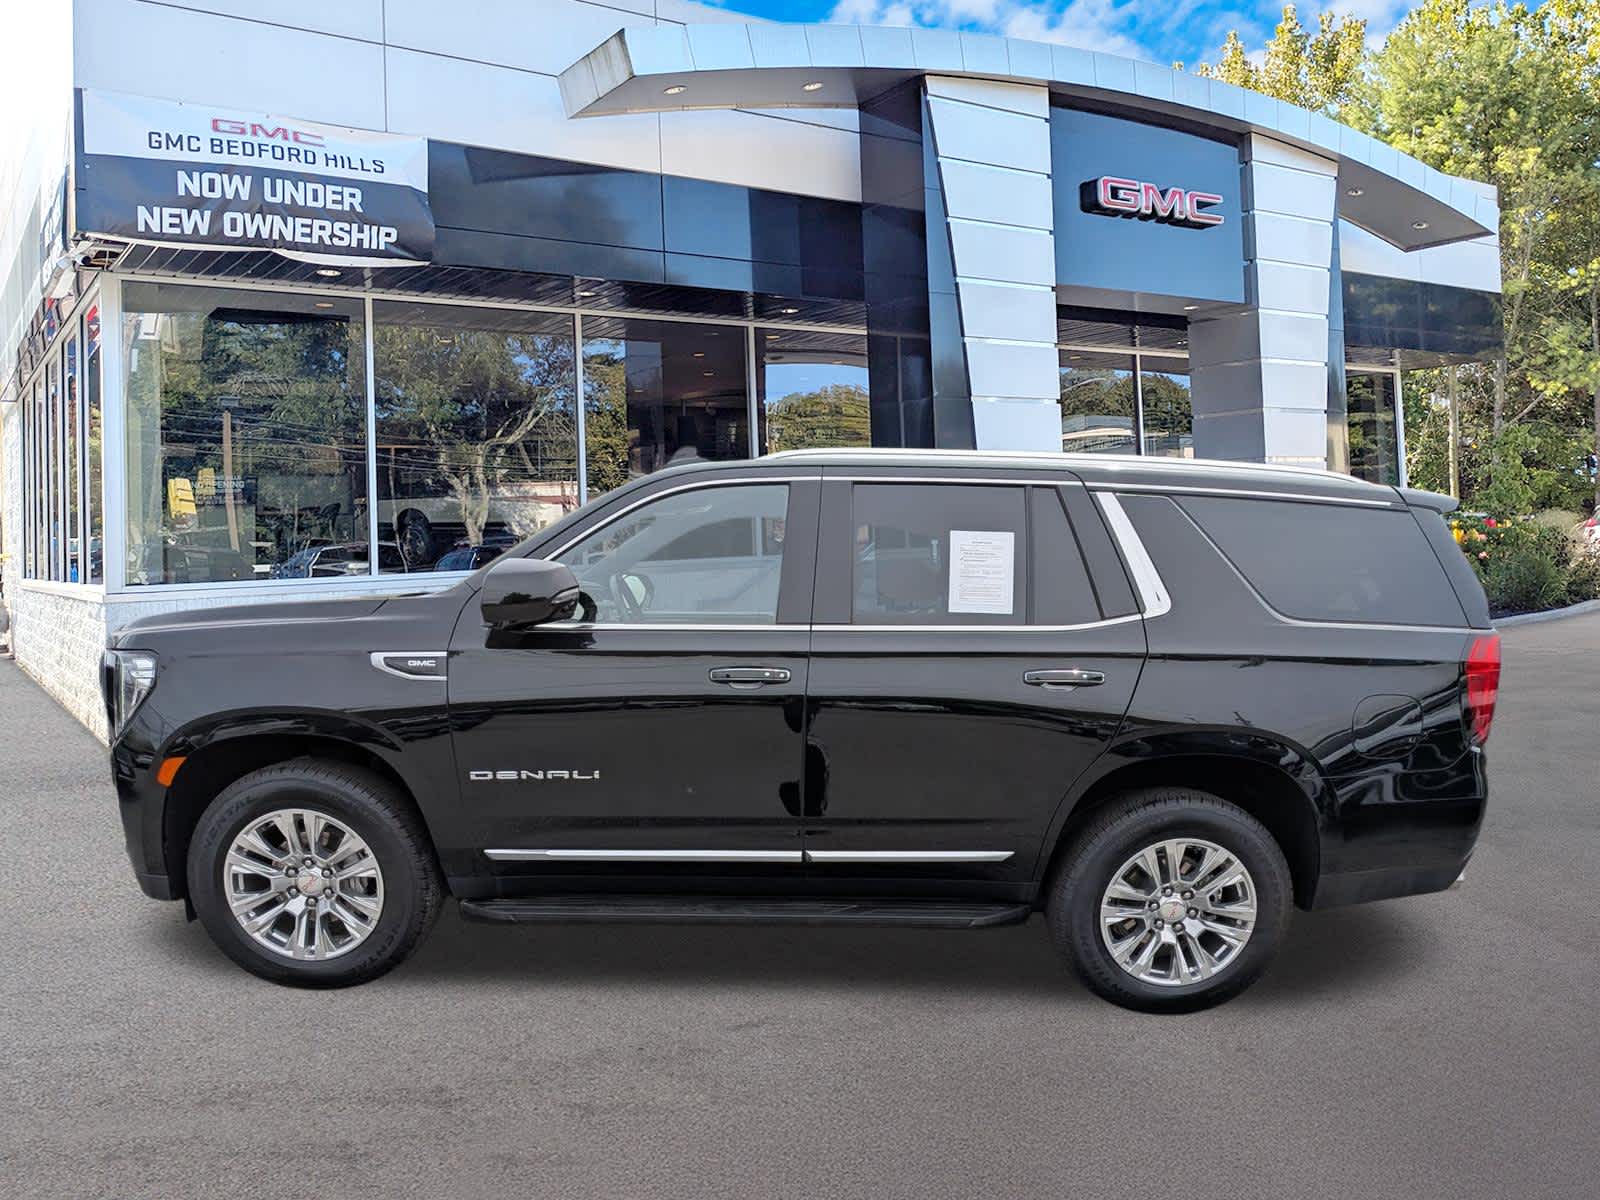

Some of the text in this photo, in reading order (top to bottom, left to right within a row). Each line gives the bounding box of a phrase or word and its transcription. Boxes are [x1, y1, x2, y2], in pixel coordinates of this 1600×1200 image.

[148, 131, 385, 174] GMC BEDFORD HILLS
[211, 118, 326, 148] GMC
[177, 170, 363, 213] NOW UNDER
[1098, 176, 1224, 224] GMC
[137, 205, 398, 250] NEW OWNERSHIP
[408, 659, 436, 667] GMC
[469, 770, 600, 781] DENALI
